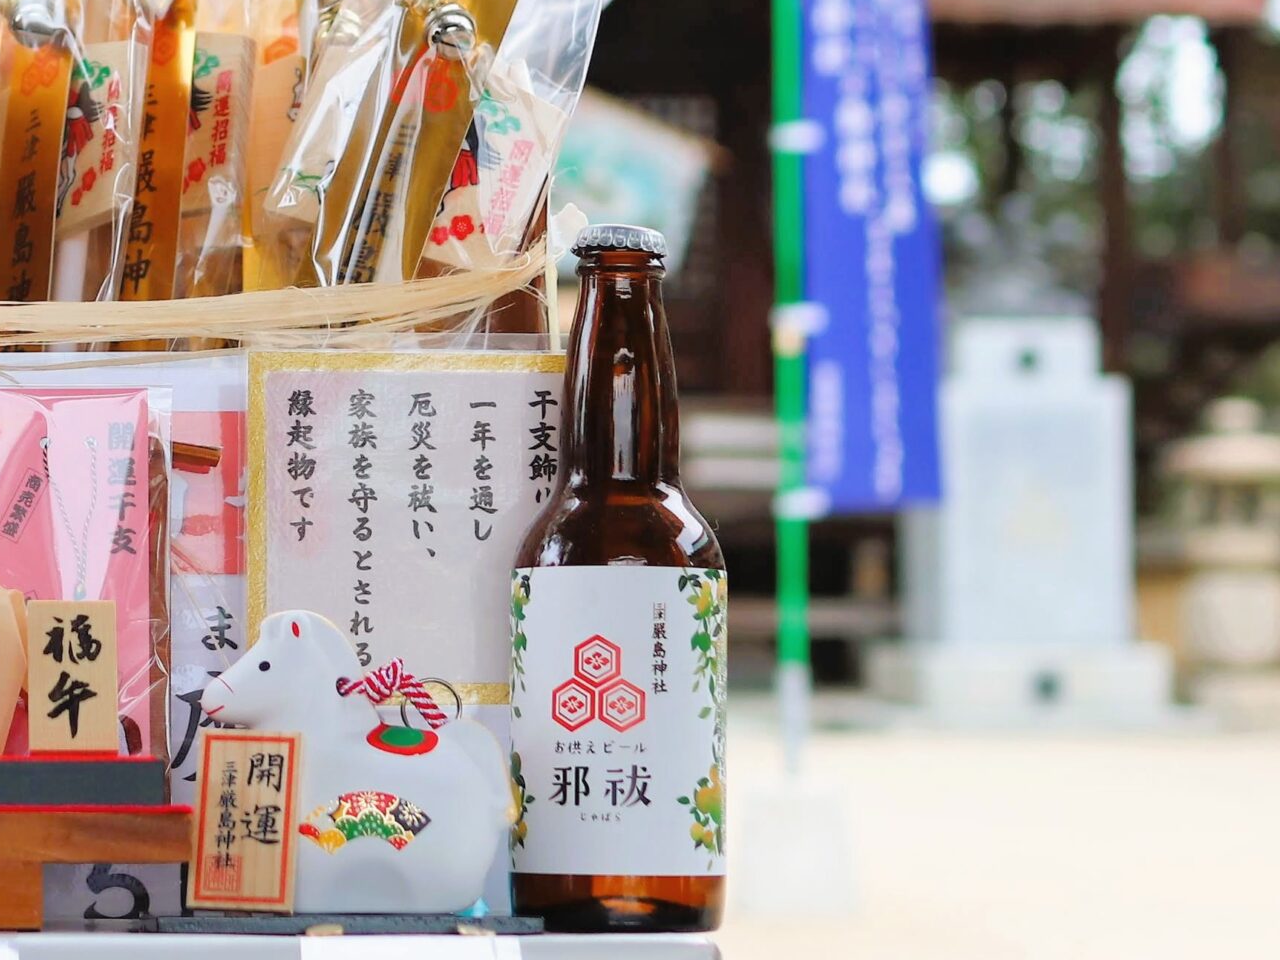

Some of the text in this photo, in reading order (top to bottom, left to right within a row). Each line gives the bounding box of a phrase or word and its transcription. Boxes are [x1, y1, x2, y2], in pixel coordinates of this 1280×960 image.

[286, 389, 317, 541] 縁起物です
[469, 400, 497, 540] 一年を通し
[348, 388, 378, 667] 家族を守るとされる
[240, 752, 284, 845] 開運
[548, 764, 653, 808] 邪祓
[554, 740, 648, 756] お供えビール
